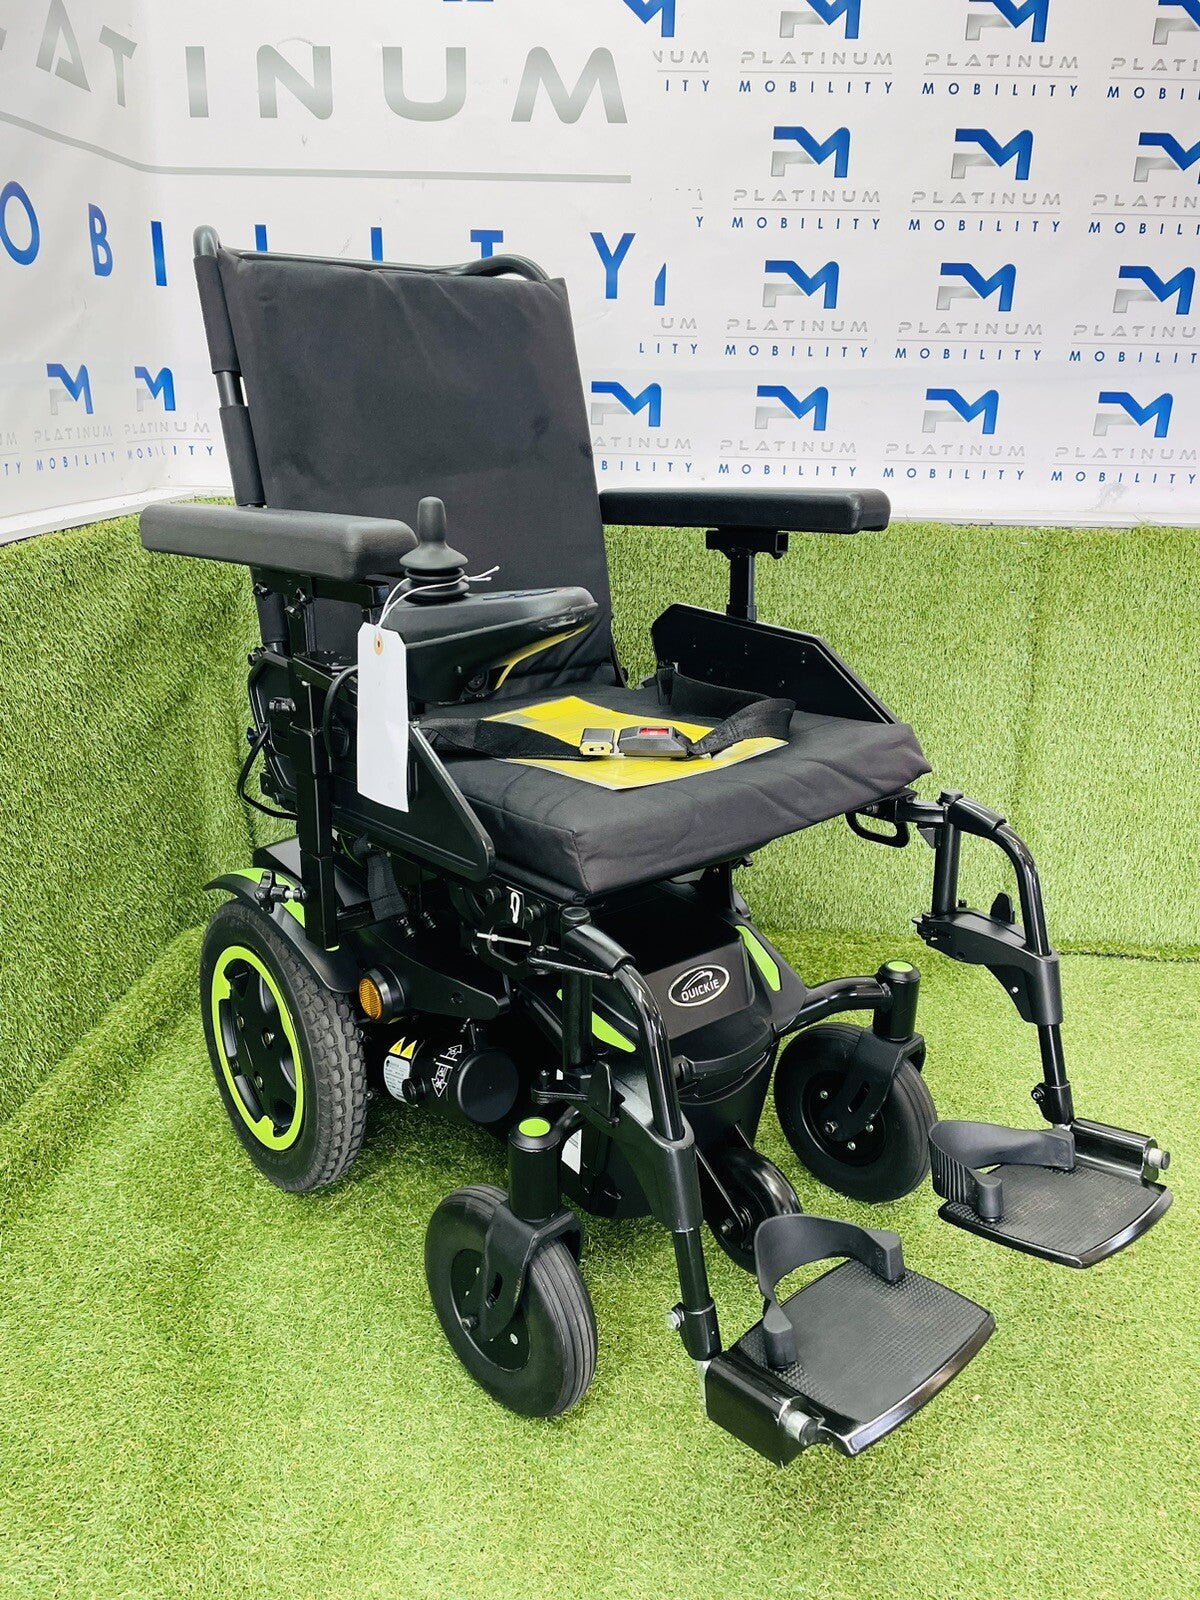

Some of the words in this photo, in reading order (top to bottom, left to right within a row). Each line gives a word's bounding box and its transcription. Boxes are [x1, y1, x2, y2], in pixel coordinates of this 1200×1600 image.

[0, 0, 628, 124] ATINUM
[740, 51, 893, 66] PLATINUM
[925, 53, 1079, 69] PLATINUM
[739, 80, 893, 94] MOBILITY
[922, 82, 1078, 97] MOBILITY
[1107, 86, 1200, 100] MOBI
[733, 189, 880, 203] PLATINUM
[911, 191, 1061, 206] PLATINUM
[732, 216, 880, 231] MOBILITY
[909, 219, 1061, 233] MOBILITY
[726, 318, 868, 333] PLATINUM
[898, 321, 1043, 336] PLATINUM
[725, 344, 868, 358] MOBILITY
[895, 347, 1042, 361] MOBILITY
[34, 424, 114, 443] PLATINUM
[124, 421, 210, 435] PLATINUM
[127, 445, 214, 460] MOBILITY
[719, 439, 857, 454] PLATINUM
[885, 443, 1025, 458] PLATINUM
[1055, 446, 1197, 461] PLATINUM
[36, 450, 115, 472] MOBILITY
[718, 463, 857, 477] MOBILITY
[883, 467, 1025, 480] MOBILITY
[1050, 470, 1197, 485] MOBILITY
[681, 978, 720, 1001] QUICKIE
